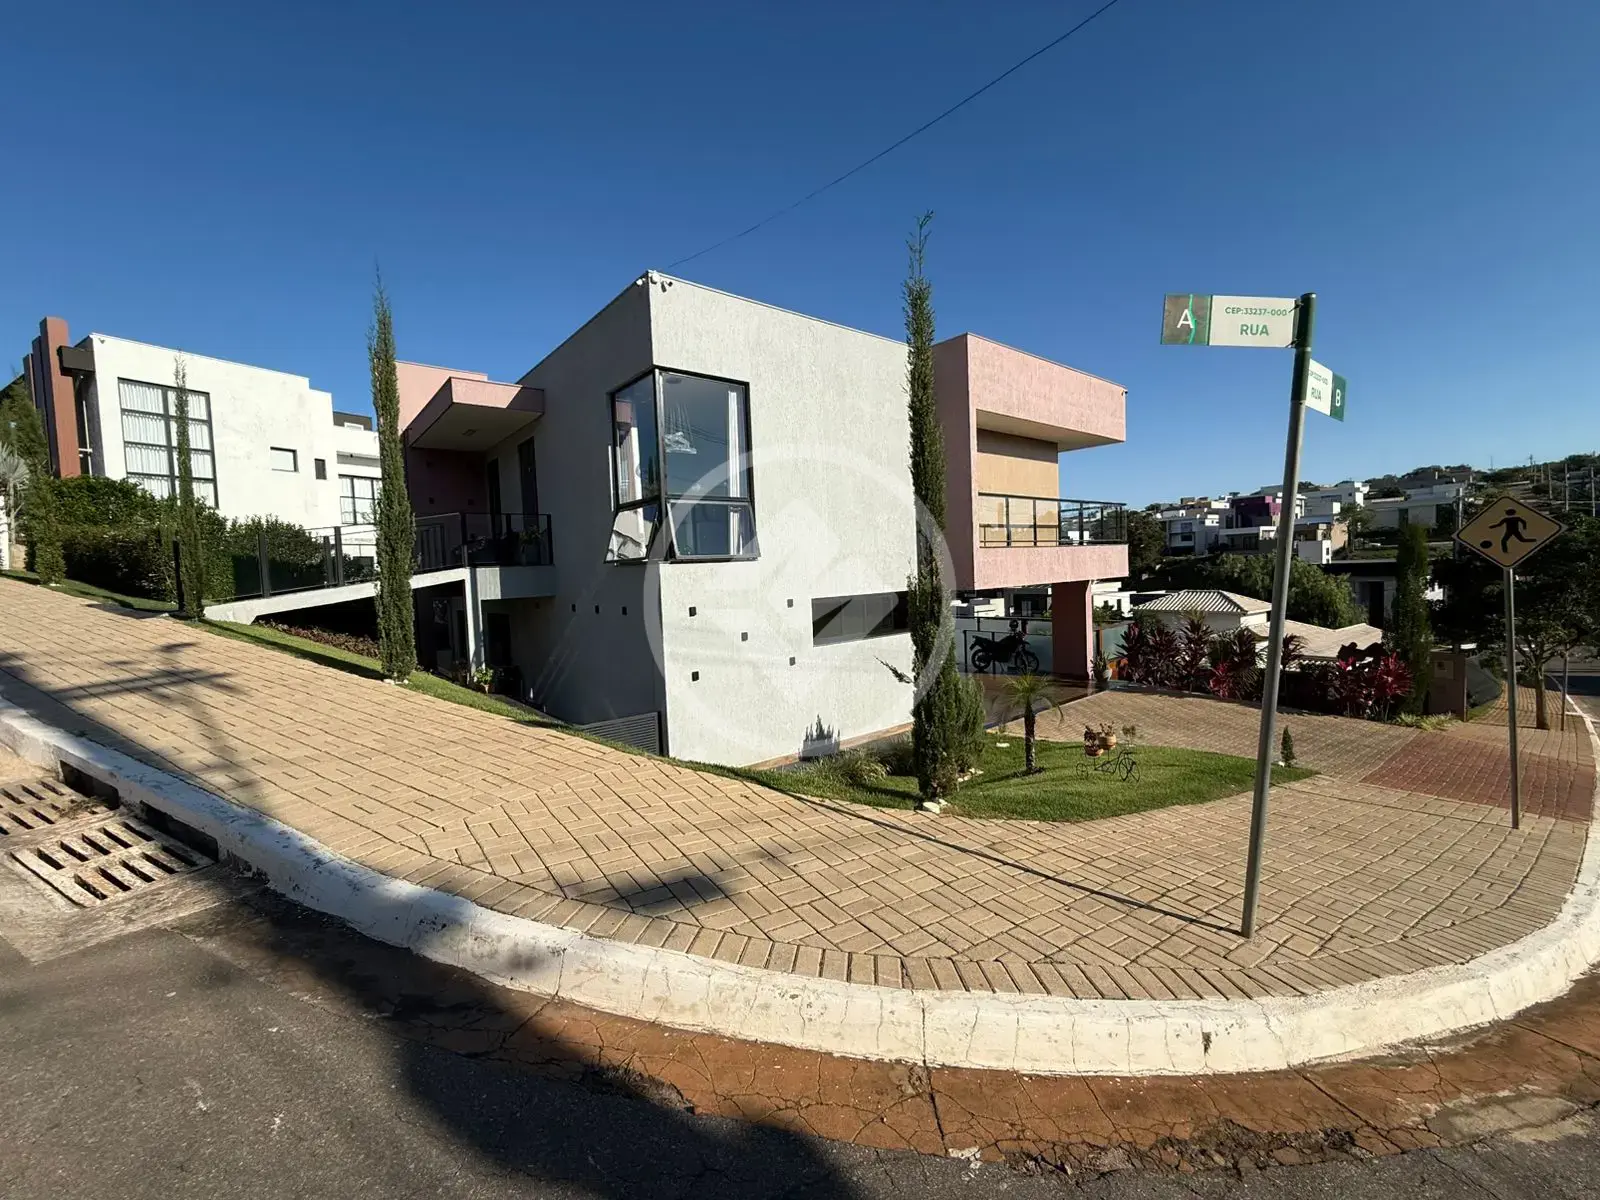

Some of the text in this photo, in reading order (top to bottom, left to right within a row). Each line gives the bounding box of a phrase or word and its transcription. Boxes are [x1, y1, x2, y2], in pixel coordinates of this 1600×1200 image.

[1225, 306, 1287, 317] CEP:33237-000
[1177, 309, 1194, 329] A
[1240, 324, 1269, 336] RUA
[1311, 387, 1322, 401] RUA
